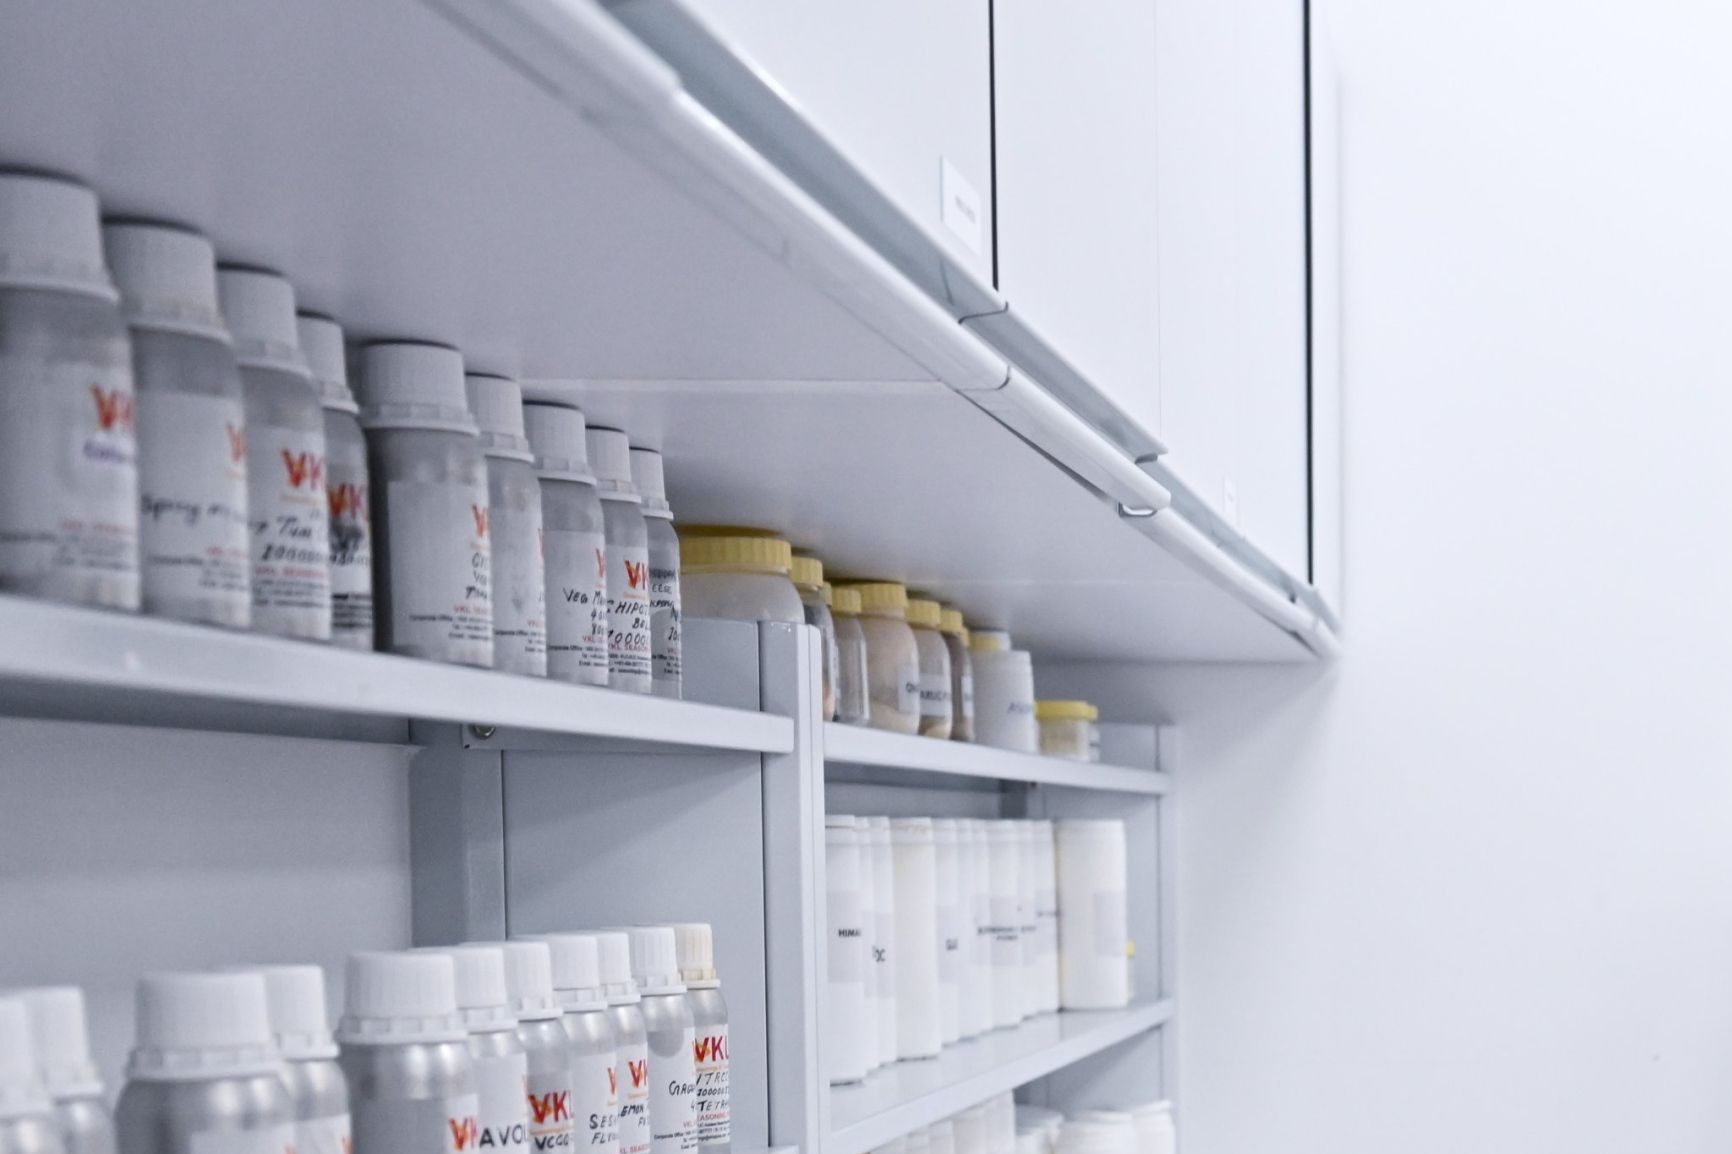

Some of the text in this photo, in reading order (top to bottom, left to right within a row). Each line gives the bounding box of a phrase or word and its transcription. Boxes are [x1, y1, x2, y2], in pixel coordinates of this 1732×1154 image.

[282, 449, 327, 491] VK
[624, 559, 648, 590] VK
[618, 1103, 645, 1118] EMON
[449, 1115, 478, 1152] VK
